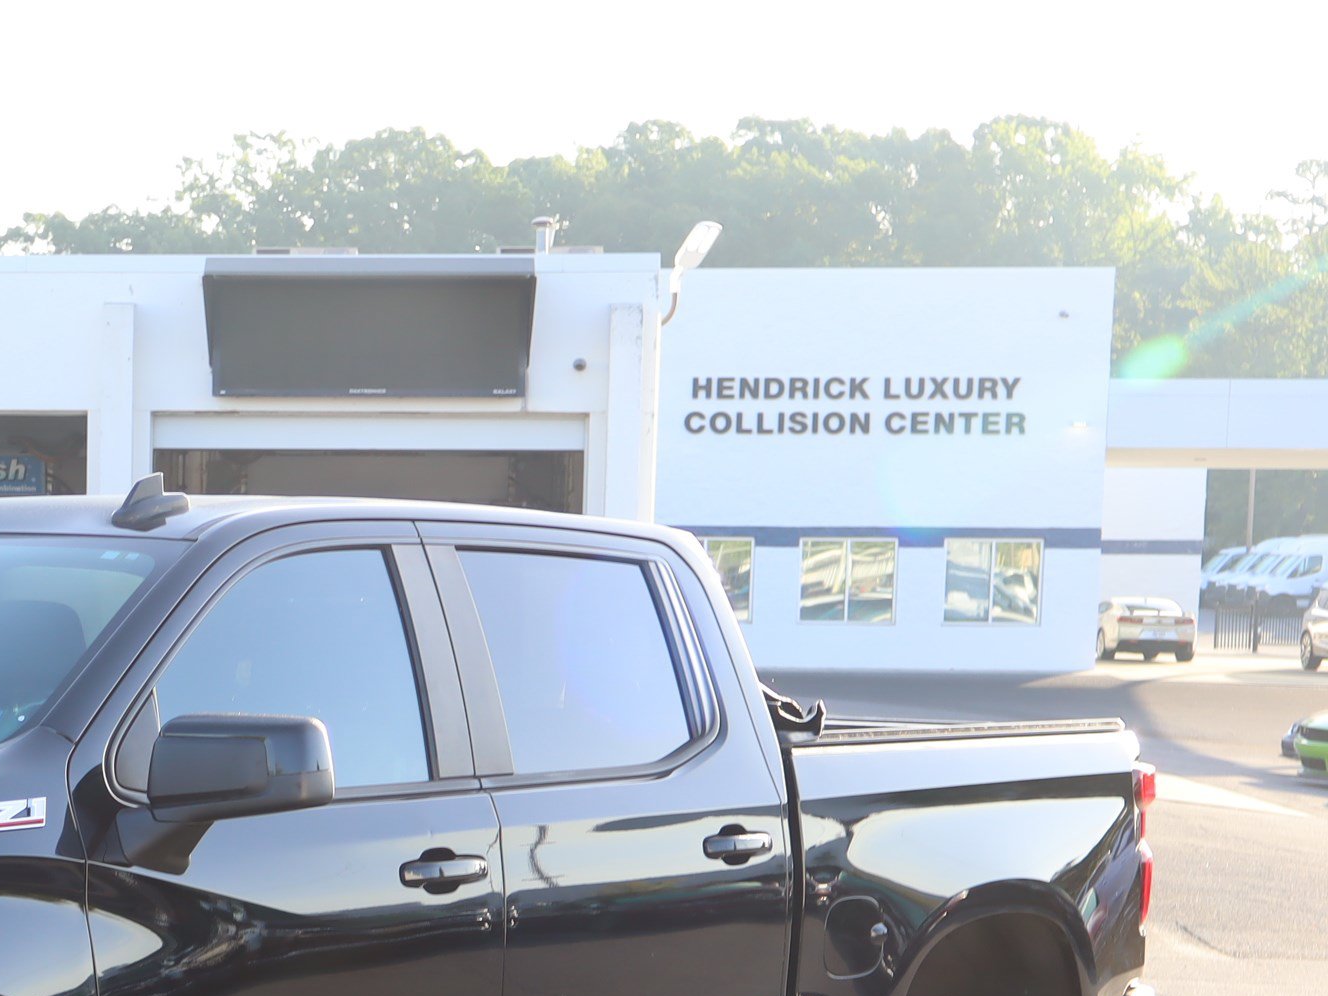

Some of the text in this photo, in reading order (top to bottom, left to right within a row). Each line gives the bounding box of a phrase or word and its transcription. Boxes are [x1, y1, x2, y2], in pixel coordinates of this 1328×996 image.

[691, 376, 1022, 401] HENDRICK LUXURY
[683, 411, 1026, 435] COLLISION CENTER
